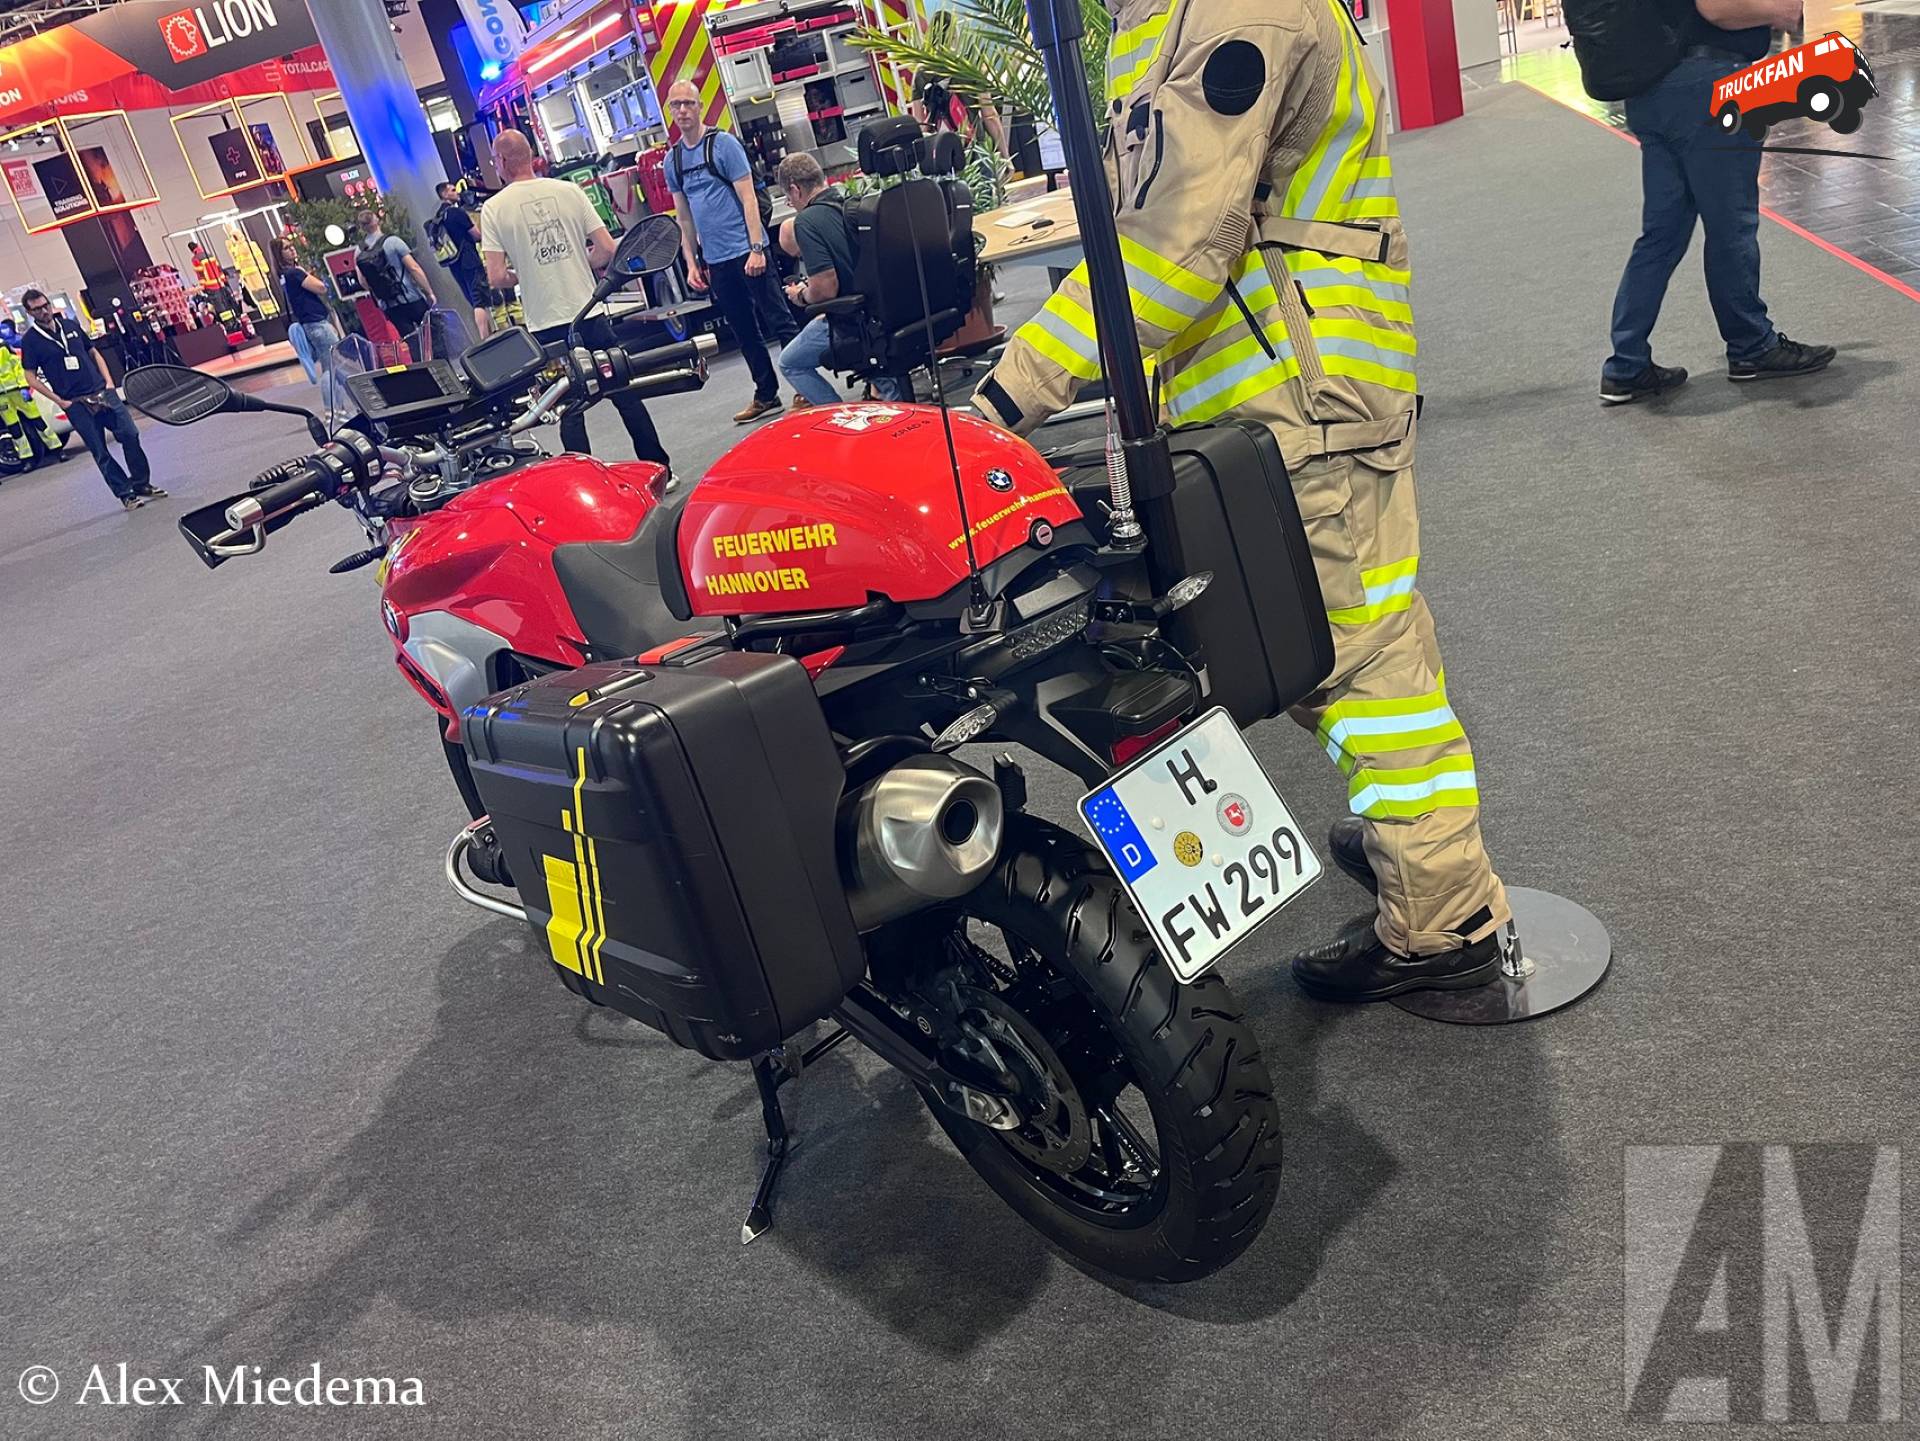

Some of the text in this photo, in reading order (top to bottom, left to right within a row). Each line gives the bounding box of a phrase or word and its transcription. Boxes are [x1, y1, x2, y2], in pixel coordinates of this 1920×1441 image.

[195, 0, 278, 48] LION
[712, 522, 838, 559] FEUERWEHR
[705, 567, 810, 596] HANNOVER
[1166, 748, 1210, 806] H
[1121, 843, 1142, 868] D
[1161, 826, 1303, 964] FW 299
